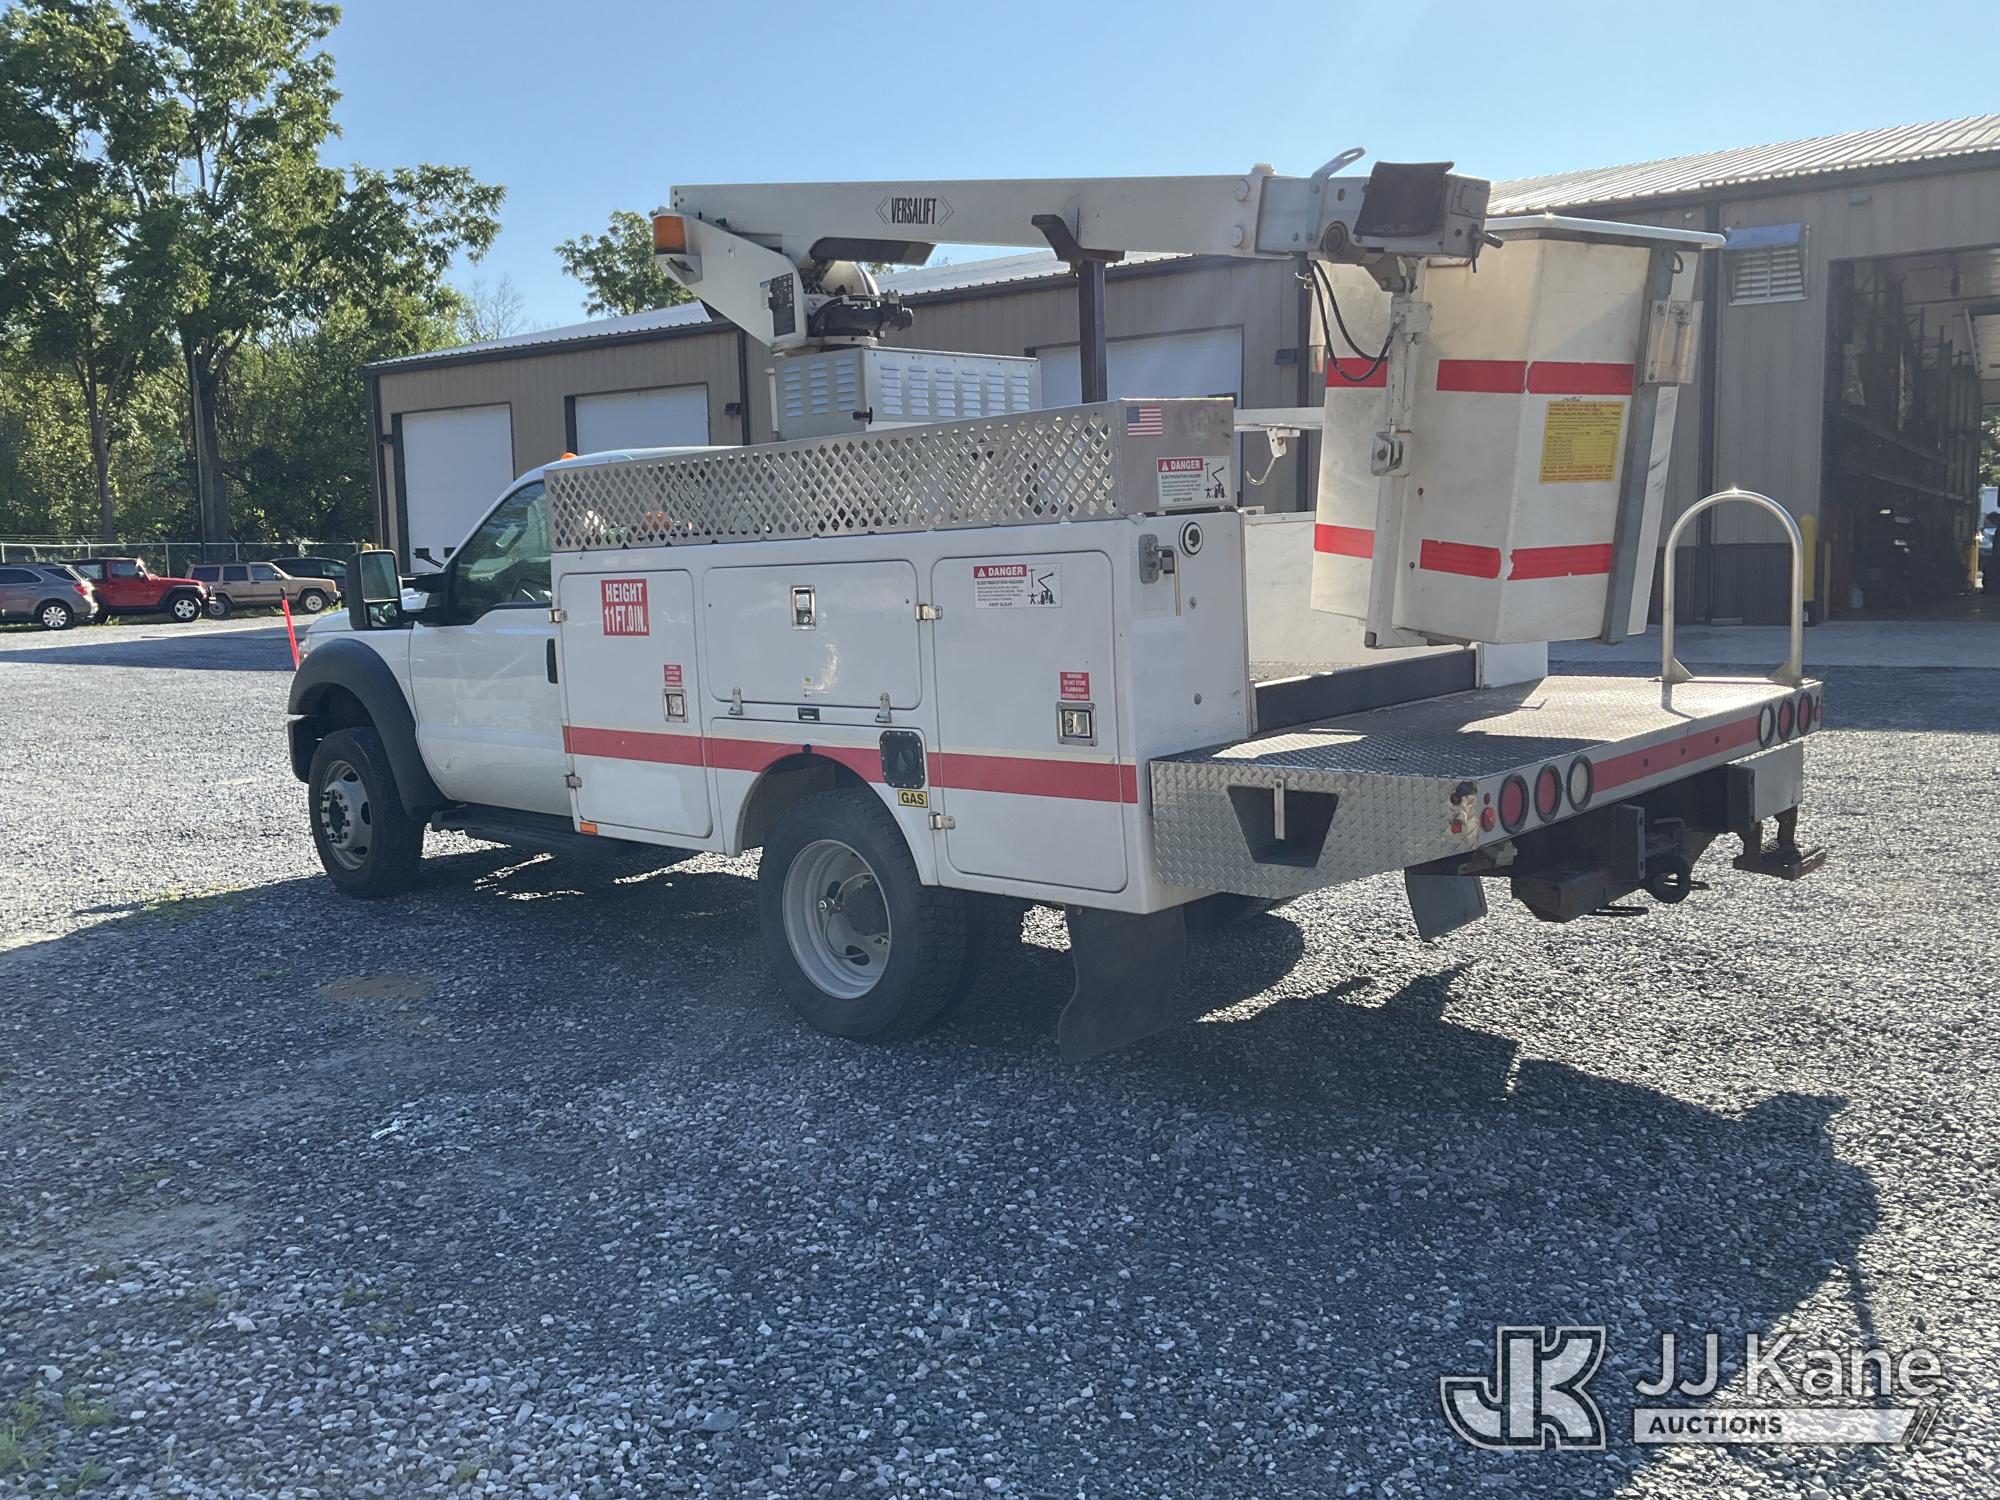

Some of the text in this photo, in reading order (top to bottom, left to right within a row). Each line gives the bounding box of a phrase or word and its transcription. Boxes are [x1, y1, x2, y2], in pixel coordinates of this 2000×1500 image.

[891, 197, 937, 225] VERSALIFT
[1170, 460, 1201, 470] DANGER
[988, 566, 1023, 577] DANGER
[605, 582, 643, 602] HEIGHT
[901, 792, 924, 805] GAS
